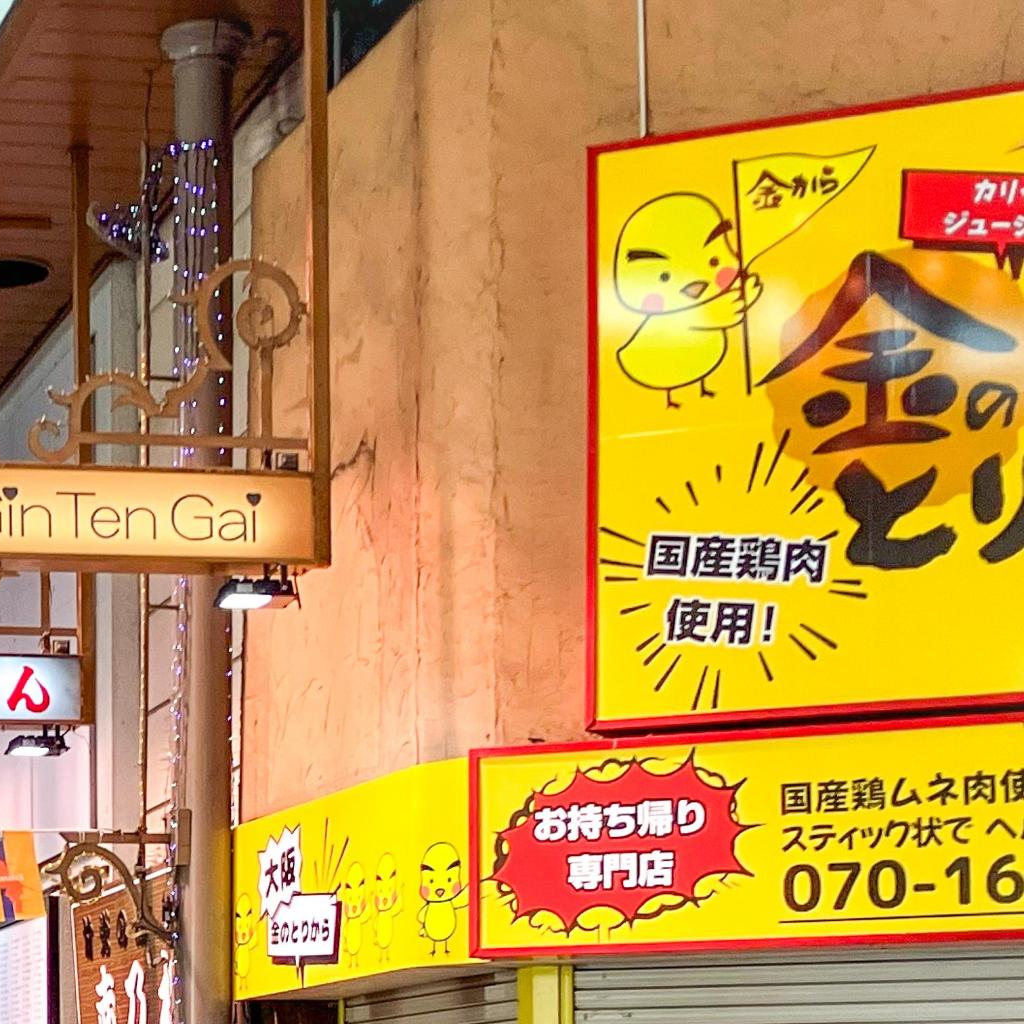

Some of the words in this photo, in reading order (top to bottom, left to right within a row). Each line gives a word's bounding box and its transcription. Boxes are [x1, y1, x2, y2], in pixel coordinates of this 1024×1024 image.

[747, 166, 839, 210] 金から
[974, 178, 1024, 205] カリ
[755, 250, 1019, 455] 金の
[647, 535, 827, 584] 国産鶏肉
[666, 599, 776, 645] 使用!
[533, 798, 707, 842] お持ち帰り
[566, 850, 675, 891] 専門店
[783, 853, 1024, 913] 070-16
[270, 918, 330, 945] 金のとりから
